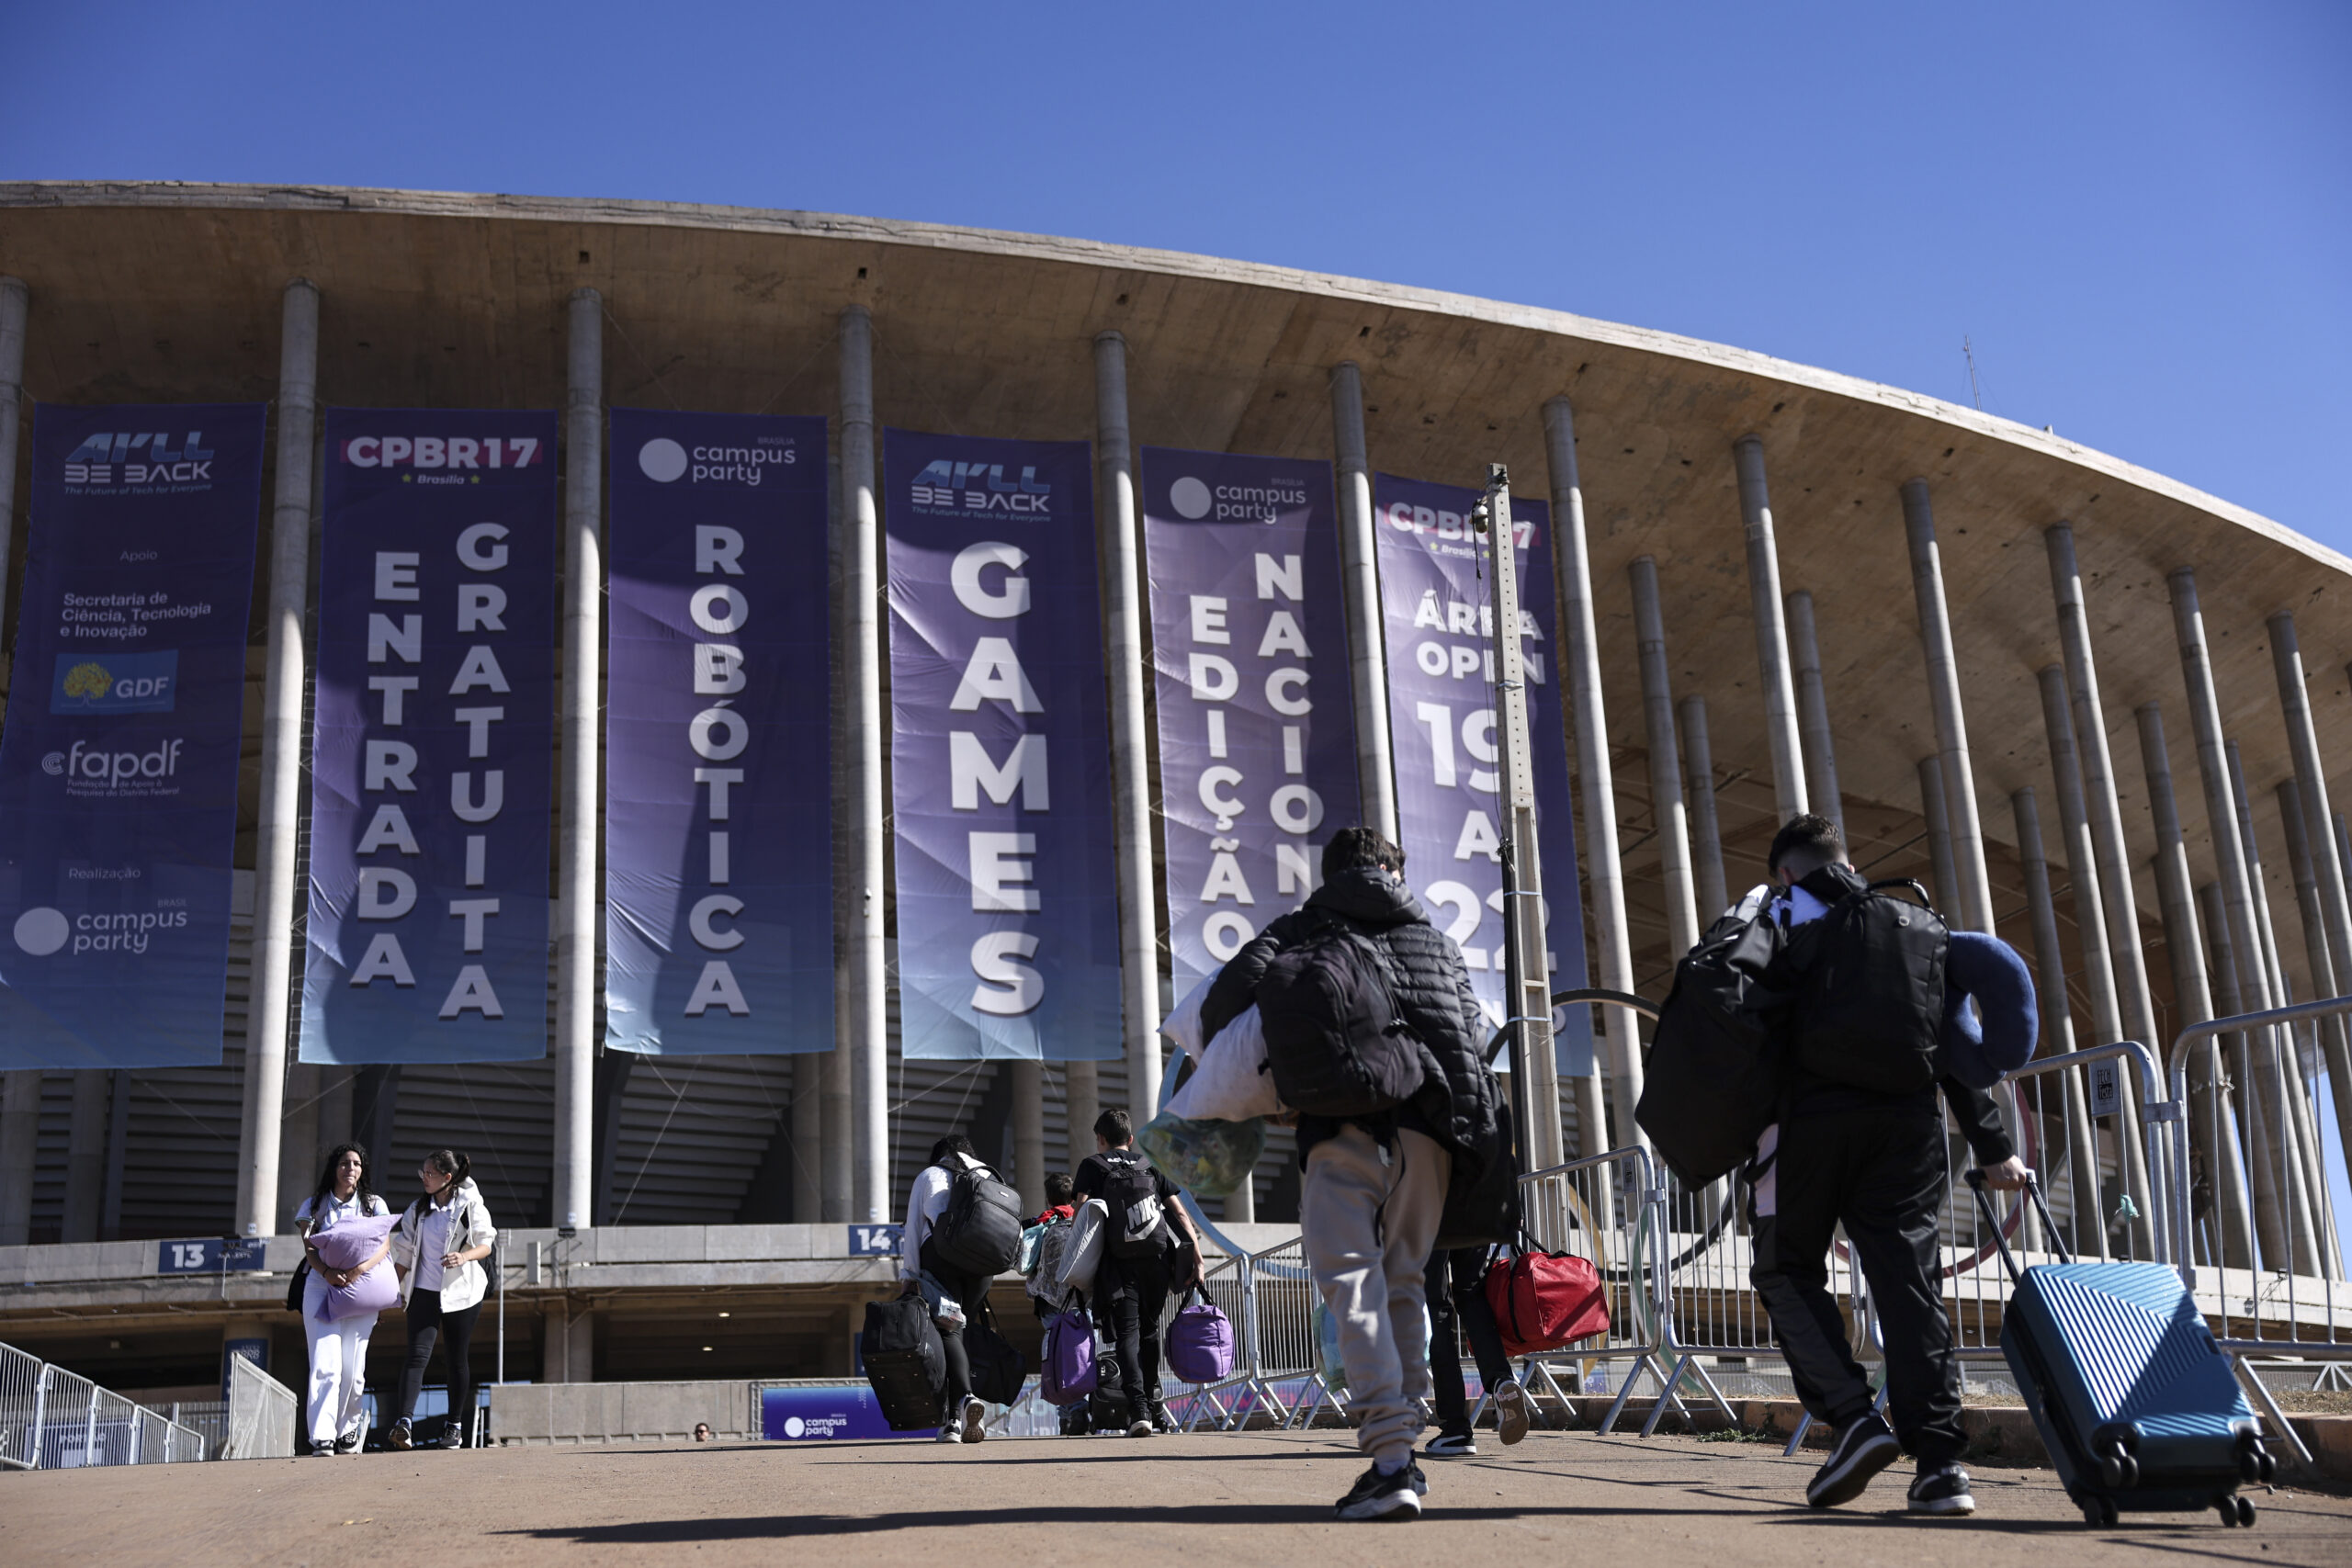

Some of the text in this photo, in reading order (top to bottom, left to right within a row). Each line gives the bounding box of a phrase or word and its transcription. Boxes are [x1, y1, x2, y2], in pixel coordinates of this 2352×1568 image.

[346, 436, 538, 468] CPBR17
[693, 446, 796, 468] campus
[64, 461, 212, 484] BE BACK
[417, 474, 465, 485] Brasília
[693, 463, 761, 486] party
[85, 486, 117, 496] Future
[132, 484, 153, 494] Tech
[155, 483, 169, 493] for
[171, 483, 212, 494] Everyone
[911, 486, 1050, 512] BE BACK
[1216, 485, 1306, 505] campus
[930, 508, 959, 517] Future
[974, 510, 993, 520] Tech
[995, 512, 1007, 521] for
[1010, 513, 1051, 524] Everyone
[1216, 502, 1276, 525] party
[119, 550, 158, 562] Apoio
[63, 592, 168, 607] Secretaria de
[62, 602, 211, 624] Ciência, Tecnologia
[60, 625, 147, 640] e Inovação
[116, 677, 169, 699] GDF
[69, 739, 183, 789] fapdf
[350, 551, 422, 987] ENTRADA
[438, 523, 511, 1021] GRATUITA
[684, 525, 750, 1017] ROBÓTICA
[950, 541, 1050, 1014] GAMES
[151, 787, 180, 796] Federal
[1454, 810, 1502, 862] A
[69, 867, 141, 880] Realização
[76, 910, 187, 933] campus
[74, 931, 149, 955] party
[1126, 1194, 1158, 1231] NIKE
[857, 1228, 891, 1250] 14
[172, 1244, 205, 1268] 13
[805, 1417, 847, 1428] campus
[805, 1426, 833, 1437] party
